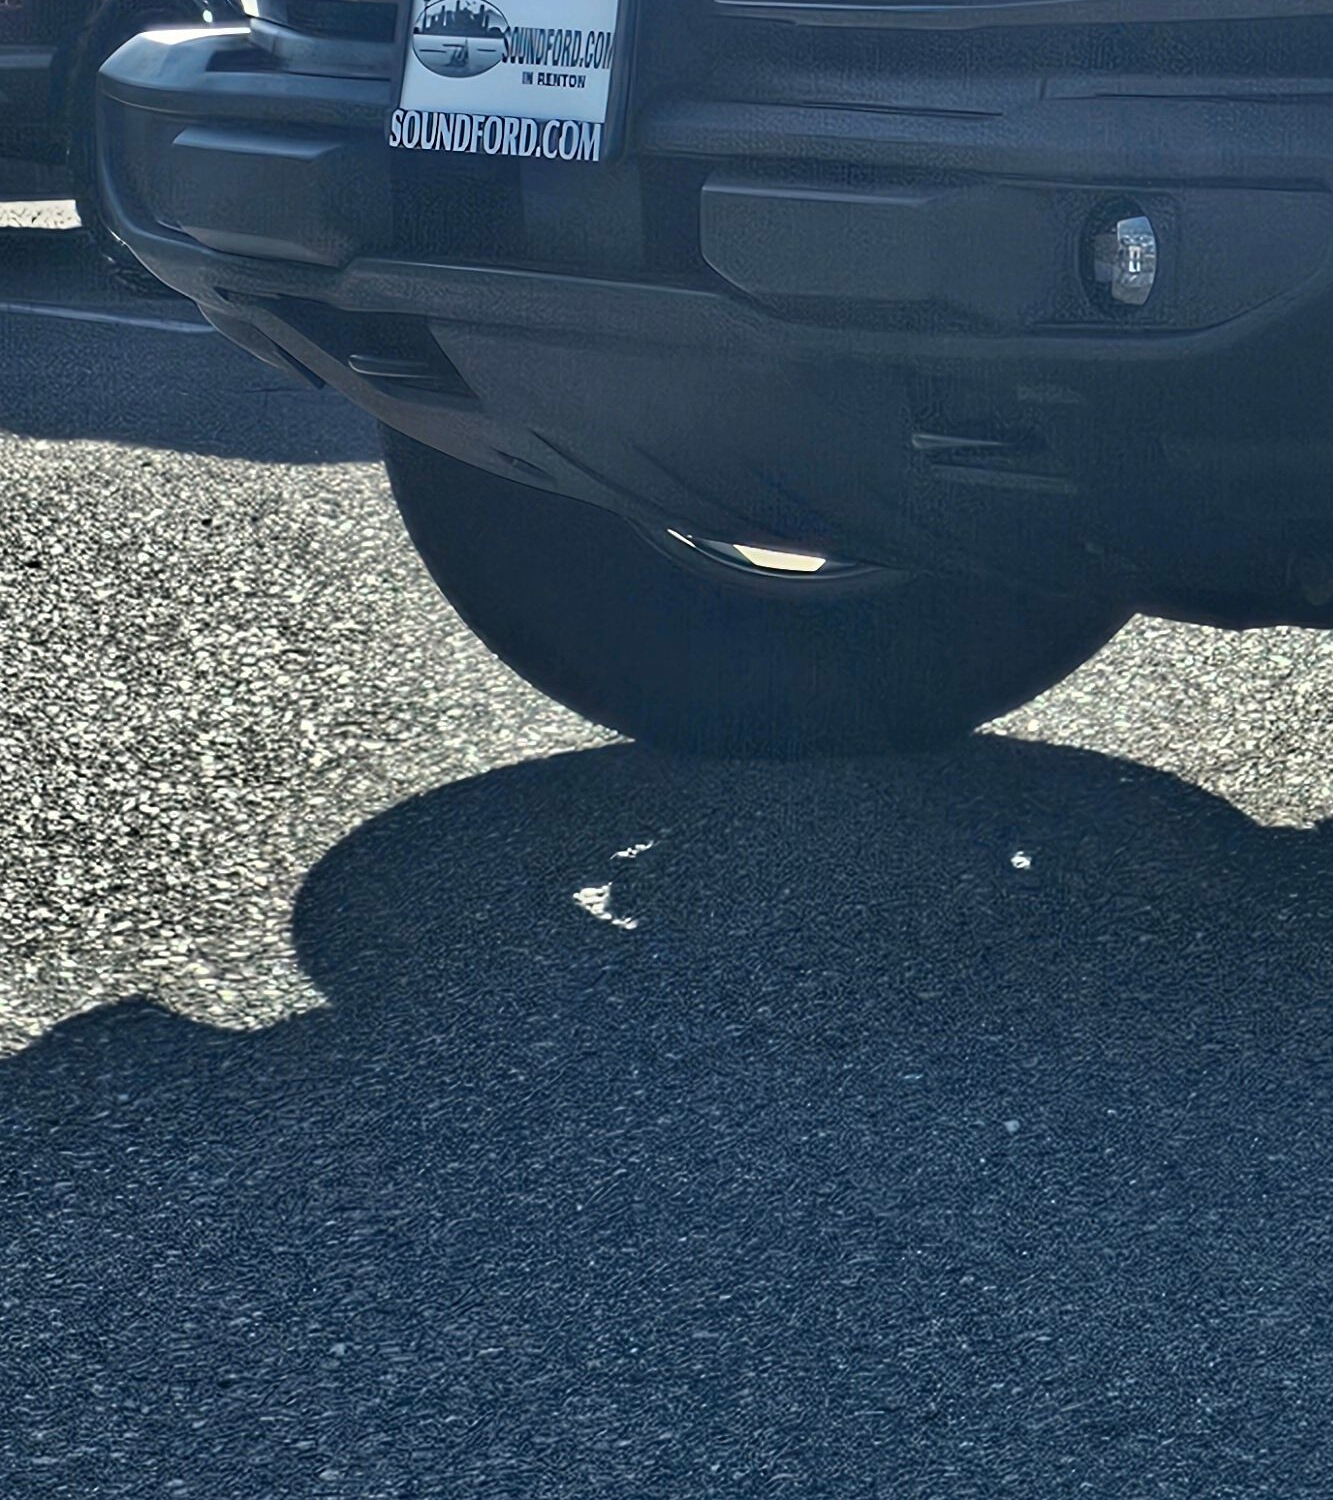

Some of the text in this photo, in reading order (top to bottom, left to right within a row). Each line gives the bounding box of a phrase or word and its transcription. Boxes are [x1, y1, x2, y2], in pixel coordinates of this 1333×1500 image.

[522, 72, 586, 88] IN RENTON
[388, 108, 601, 162] SOUNDFORD.COM
